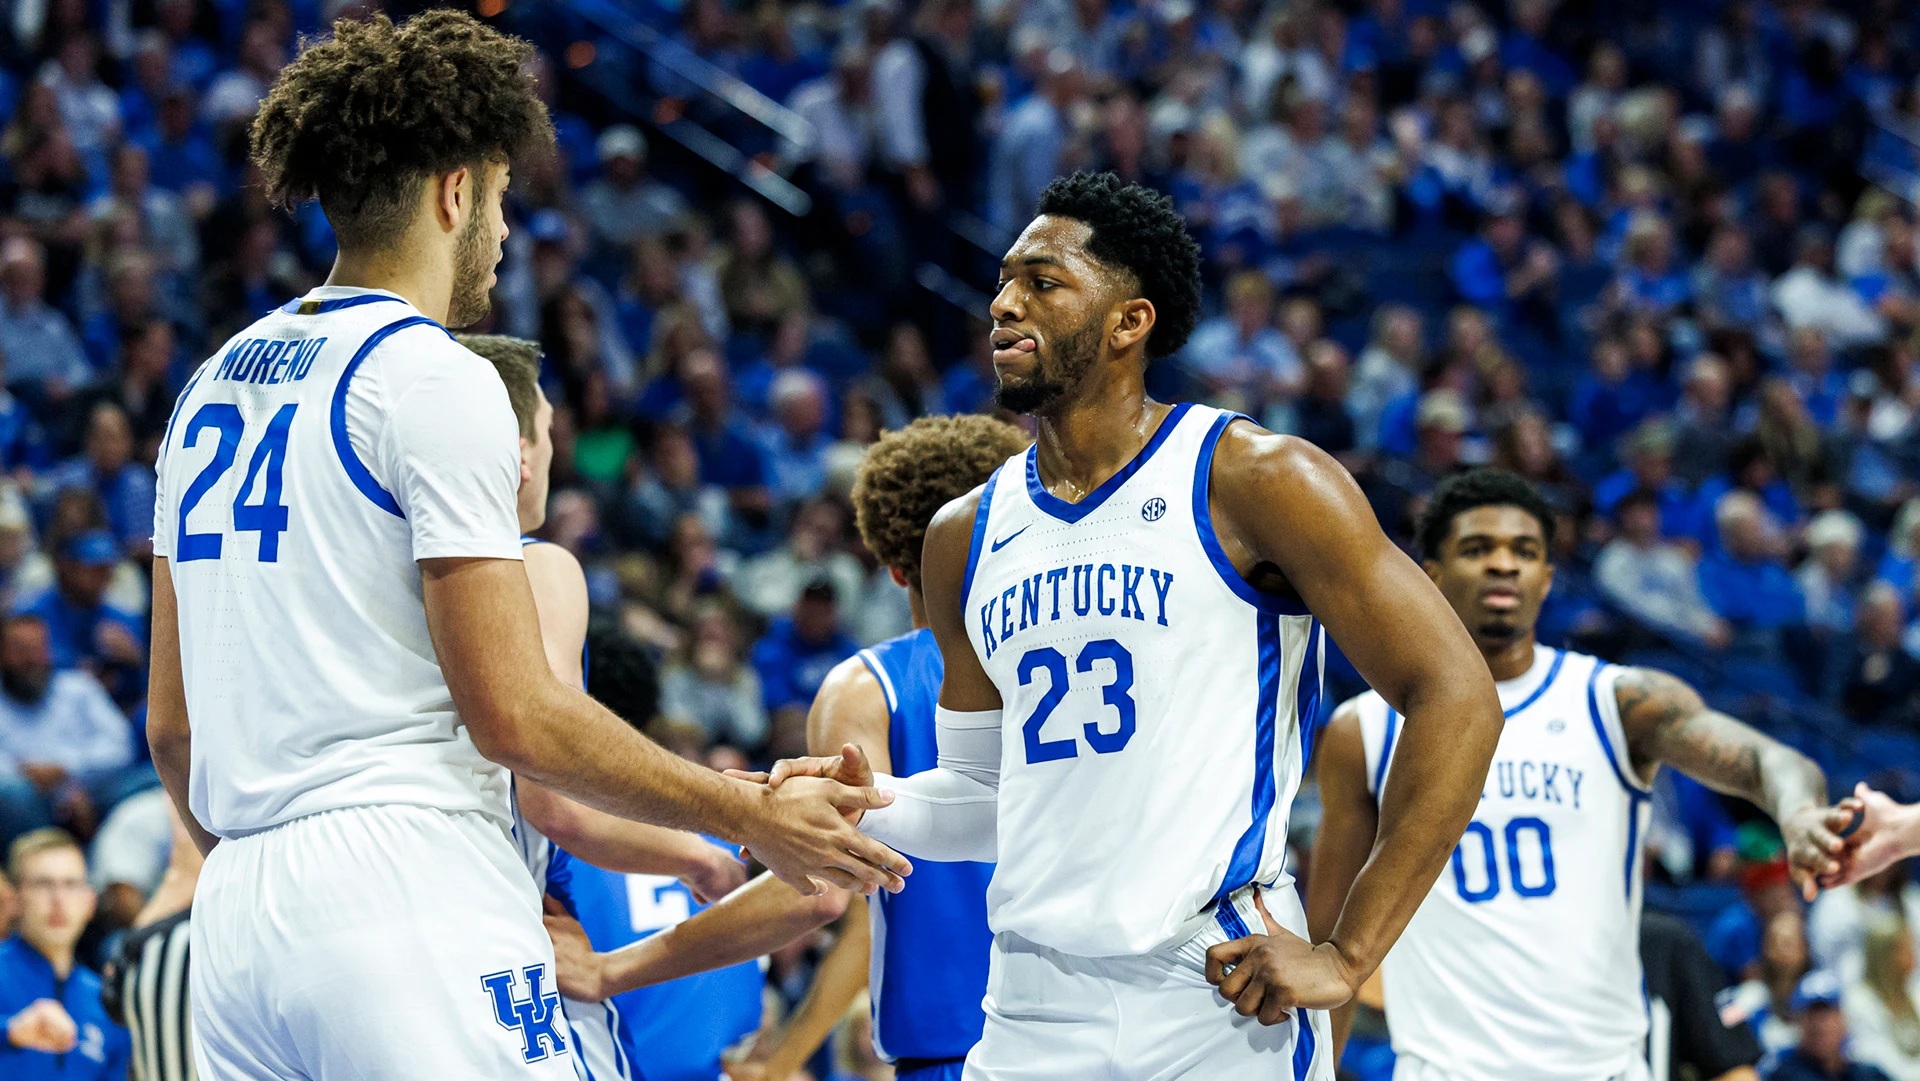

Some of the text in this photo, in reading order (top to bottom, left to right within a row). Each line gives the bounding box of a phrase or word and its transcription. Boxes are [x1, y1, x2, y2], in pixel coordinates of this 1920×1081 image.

[213, 337, 328, 384] MORENO
[177, 403, 298, 562] 24
[1142, 497, 1166, 521] SEC
[981, 563, 1174, 660] KENTUCKY
[1017, 638, 1136, 765] 23
[1481, 761, 1583, 809] UCKY
[1453, 817, 1556, 902] 00
[480, 963, 568, 1063] UK
